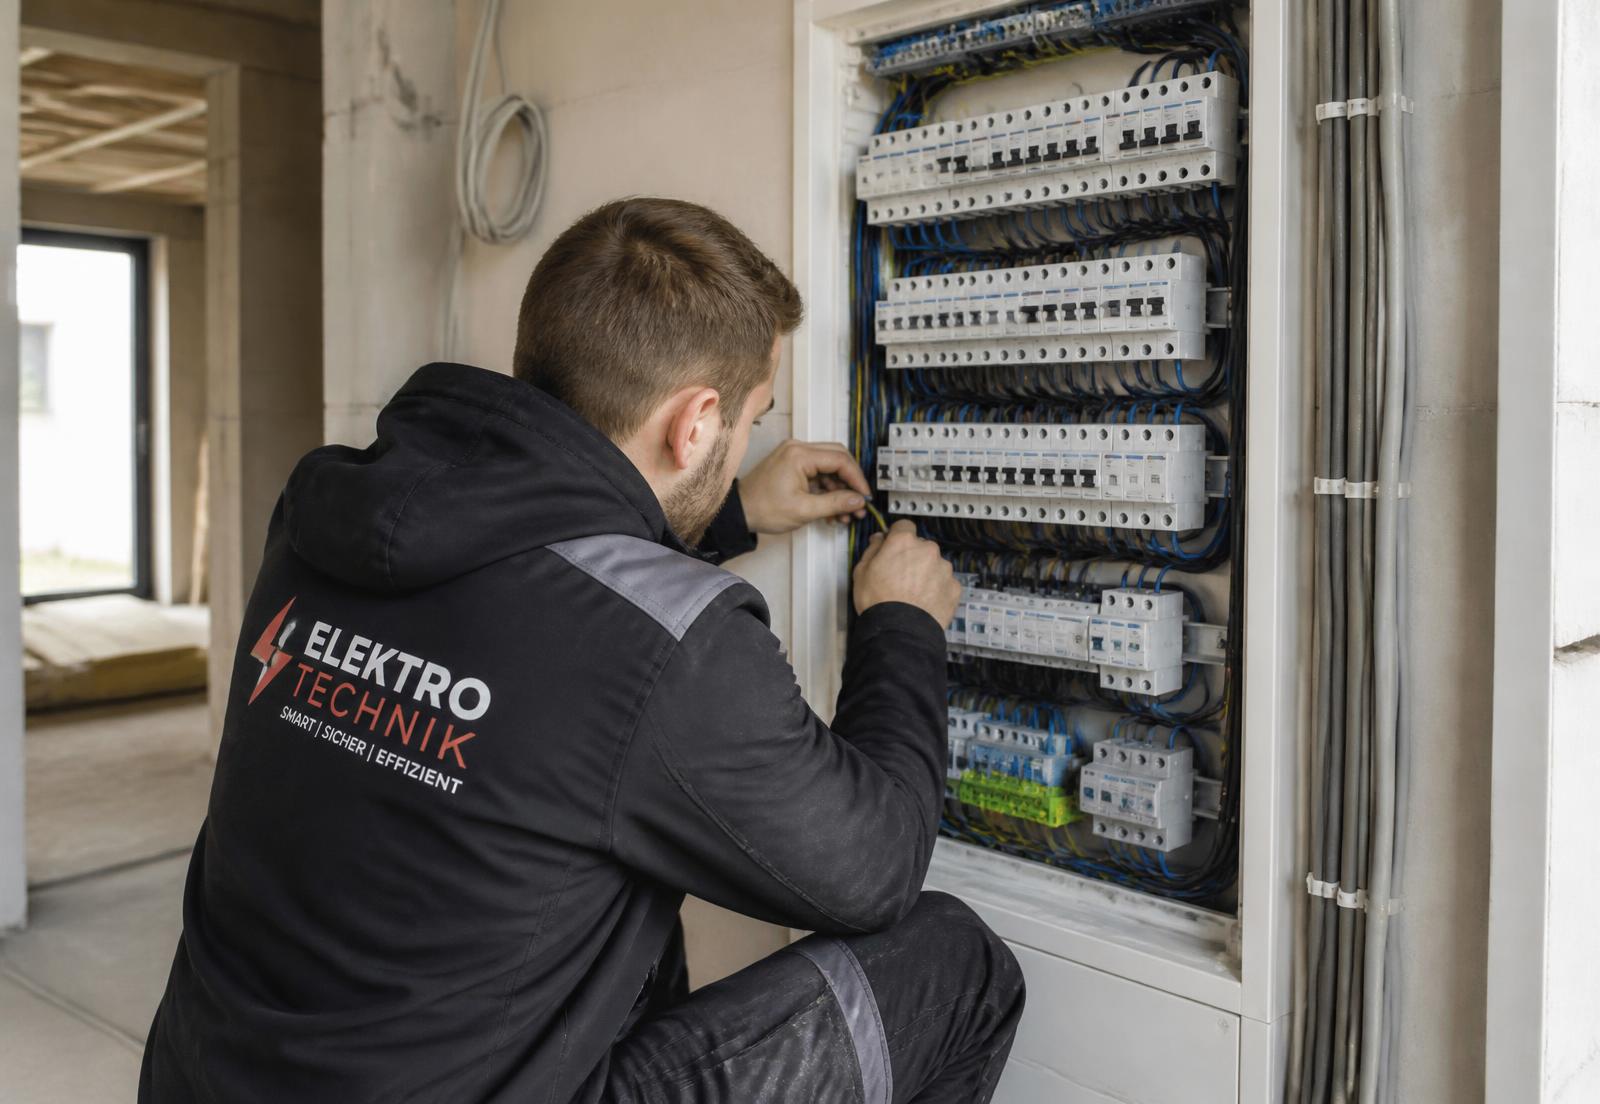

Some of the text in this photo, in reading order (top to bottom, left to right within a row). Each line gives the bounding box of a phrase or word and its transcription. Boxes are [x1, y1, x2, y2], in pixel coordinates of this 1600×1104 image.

[292, 662, 476, 769] TECHNIK
[304, 620, 491, 721] ELEKTRO
[280, 705, 317, 732] SMART
[321, 725, 367, 756] SICHER
[375, 749, 463, 794] EFFIZIENT
